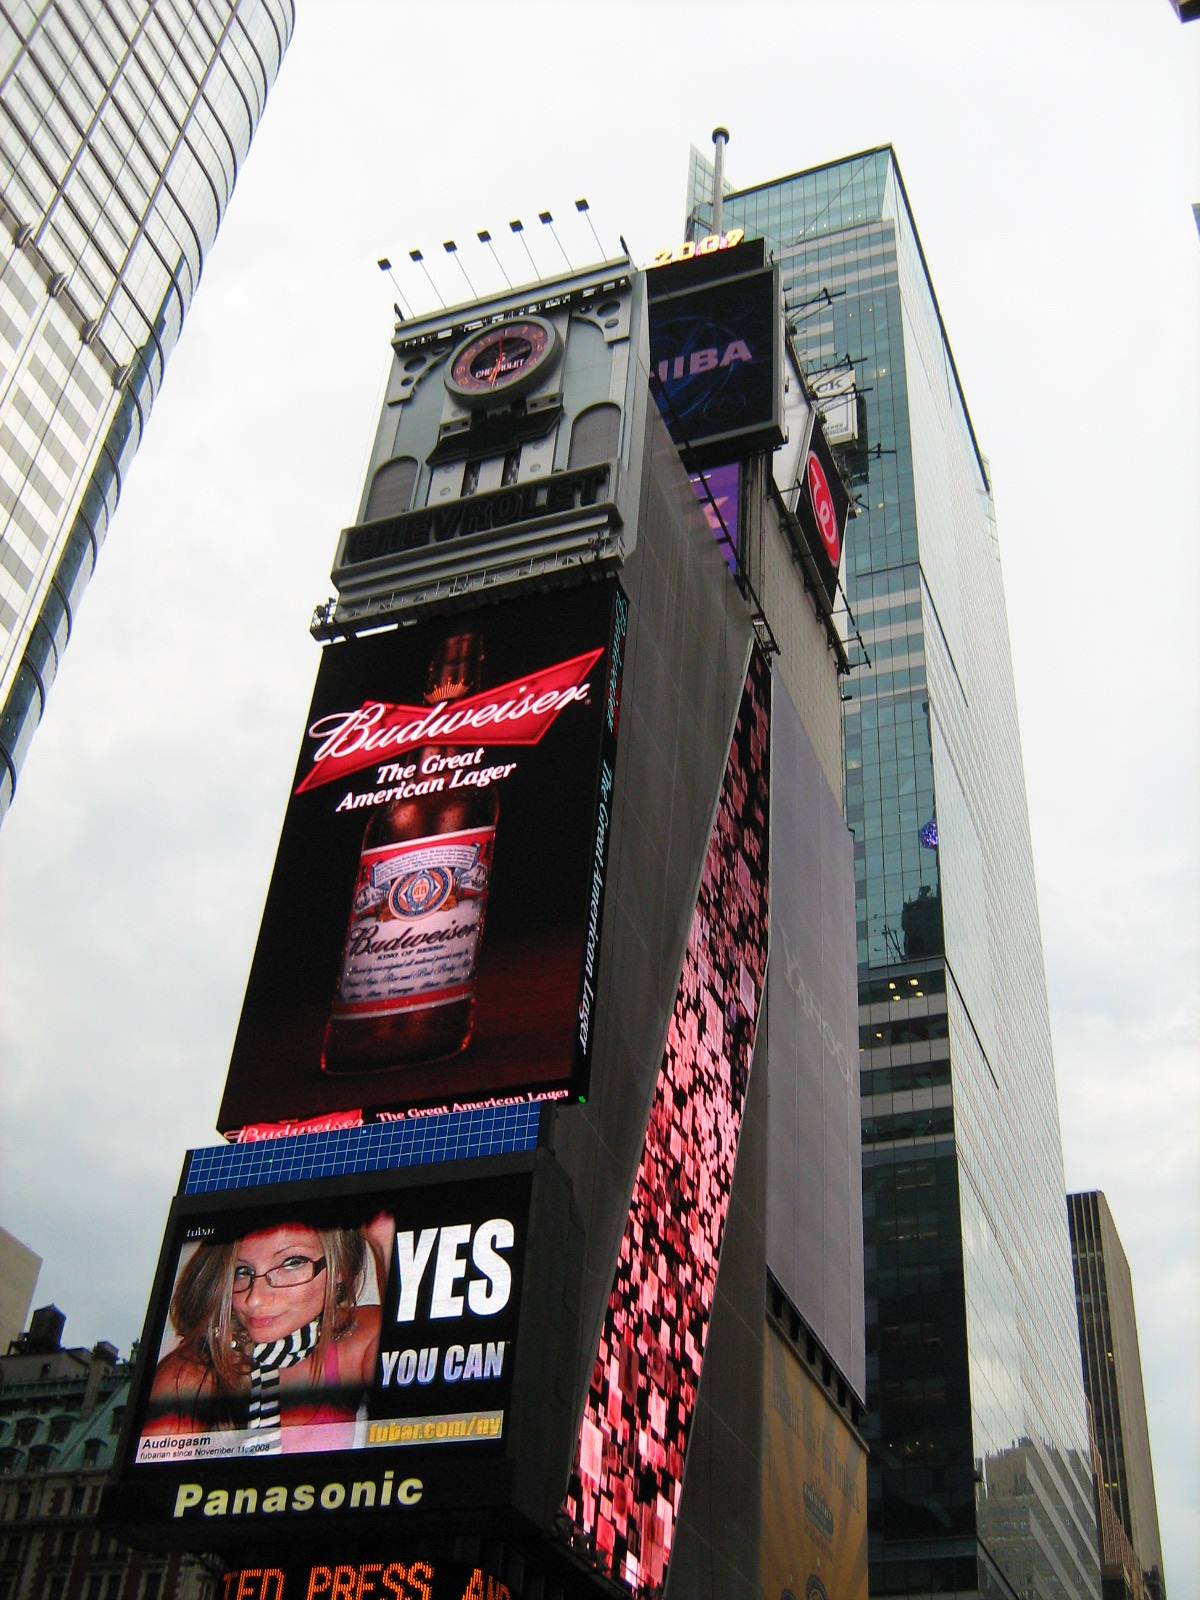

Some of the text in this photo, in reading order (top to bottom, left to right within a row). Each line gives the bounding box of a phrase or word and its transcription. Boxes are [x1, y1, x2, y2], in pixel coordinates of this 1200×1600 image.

[354, 474, 608, 558] CHEVROLET
[309, 683, 590, 762] Budweiser
[336, 762, 517, 812] American Lager
[376, 747, 484, 785] The Great
[349, 920, 478, 956] Budweiser
[585, 864, 604, 975] American
[579, 982, 594, 1055] Lager
[376, 1111, 405, 1123] The
[407, 1106, 449, 1119] Great
[452, 1095, 525, 1113] American
[528, 1088, 569, 1104] Lager
[397, 1218, 515, 1322] YES
[381, 1341, 506, 1386] YOU CAN
[142, 1436, 211, 1449] Audiogasm
[368, 1415, 501, 1443] fubar.com/ny
[173, 1450, 192, 1458] since
[194, 1446, 235, 1457] November
[173, 1471, 425, 1518] Panasonic
[306, 1561, 435, 1600] PRESS
